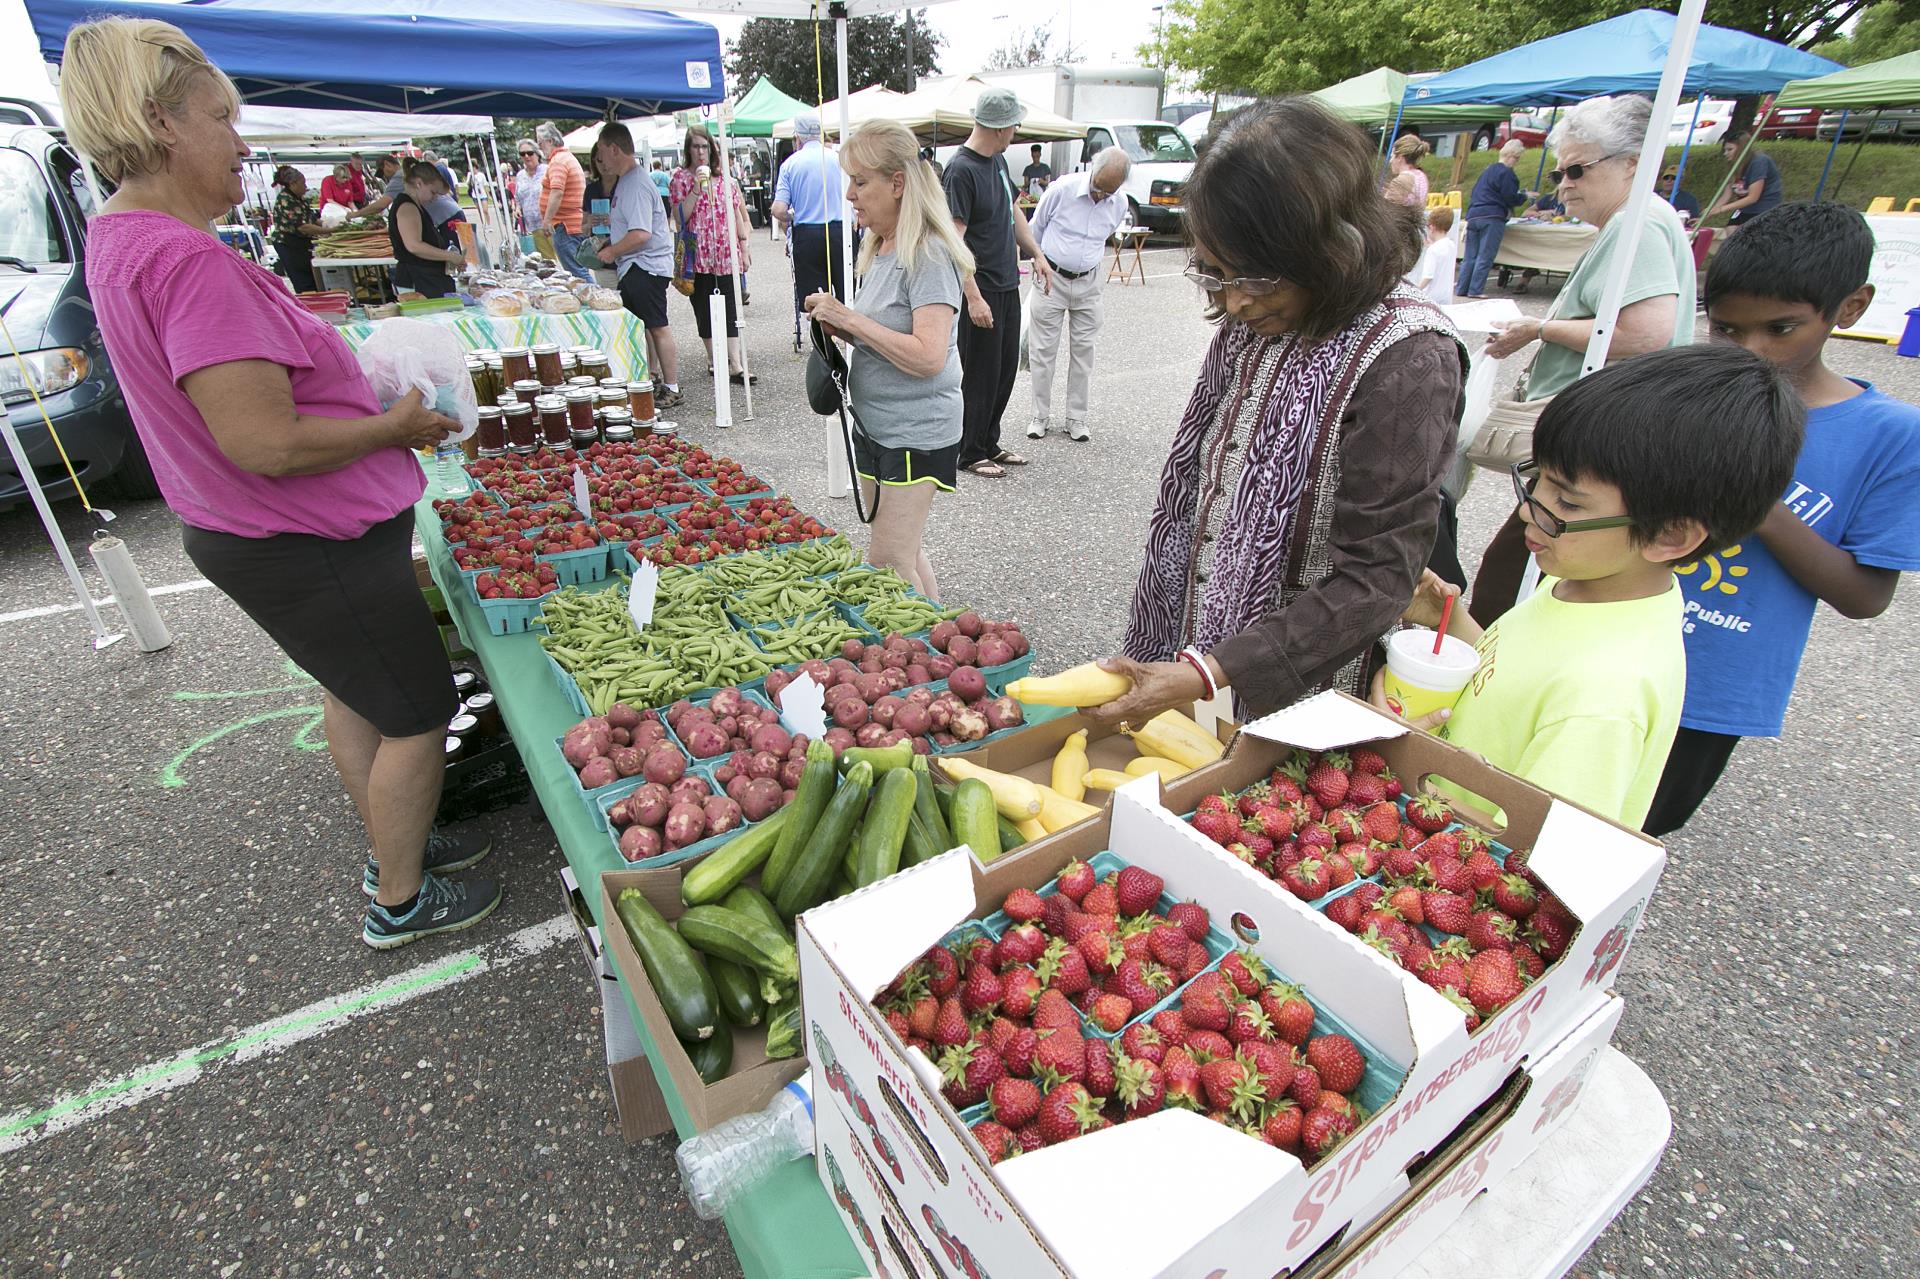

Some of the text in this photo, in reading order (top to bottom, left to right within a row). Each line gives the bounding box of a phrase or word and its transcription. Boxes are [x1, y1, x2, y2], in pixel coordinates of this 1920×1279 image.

[1684, 600, 1752, 633] Public
[839, 991, 928, 1129] Strawberries
[1286, 986, 1548, 1250] STRAWBERRIES
[849, 1132, 927, 1279] Strawberries
[961, 1163, 1004, 1223] Produce of
[968, 1185, 993, 1224] U.S.A.
[1338, 1131, 1505, 1279] AWBERRIES
